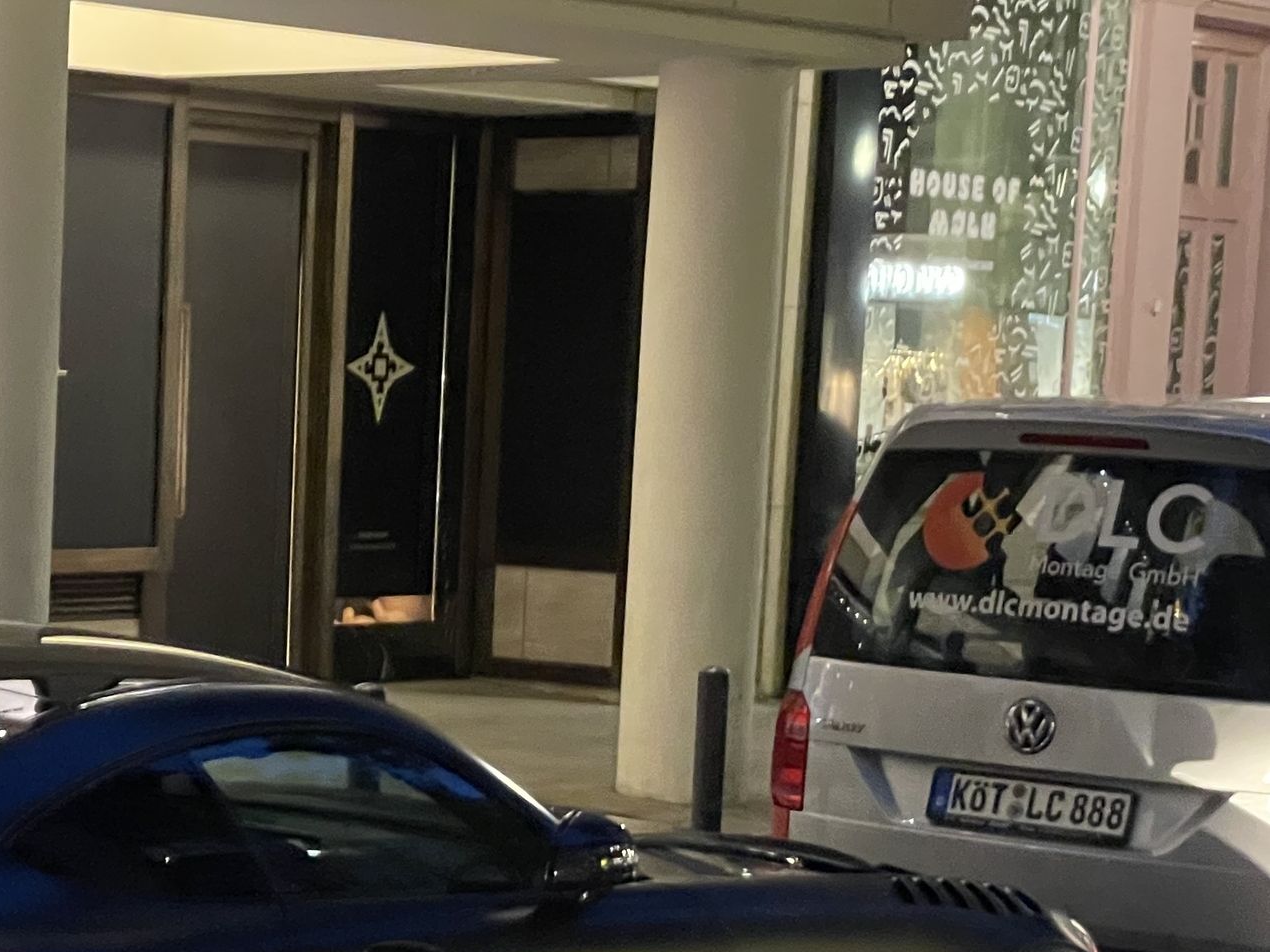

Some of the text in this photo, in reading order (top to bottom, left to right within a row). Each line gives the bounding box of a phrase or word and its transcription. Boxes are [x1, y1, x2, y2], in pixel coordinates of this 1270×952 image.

[909, 167, 1022, 205] HOUSE OF
[1034, 474, 1216, 554] DLC
[1130, 561, 1201, 590] GmbH
[908, 588, 1190, 633] www.dlcmontage.de
[1026, 786, 1066, 823] LC
[1070, 793, 1126, 831] 888
